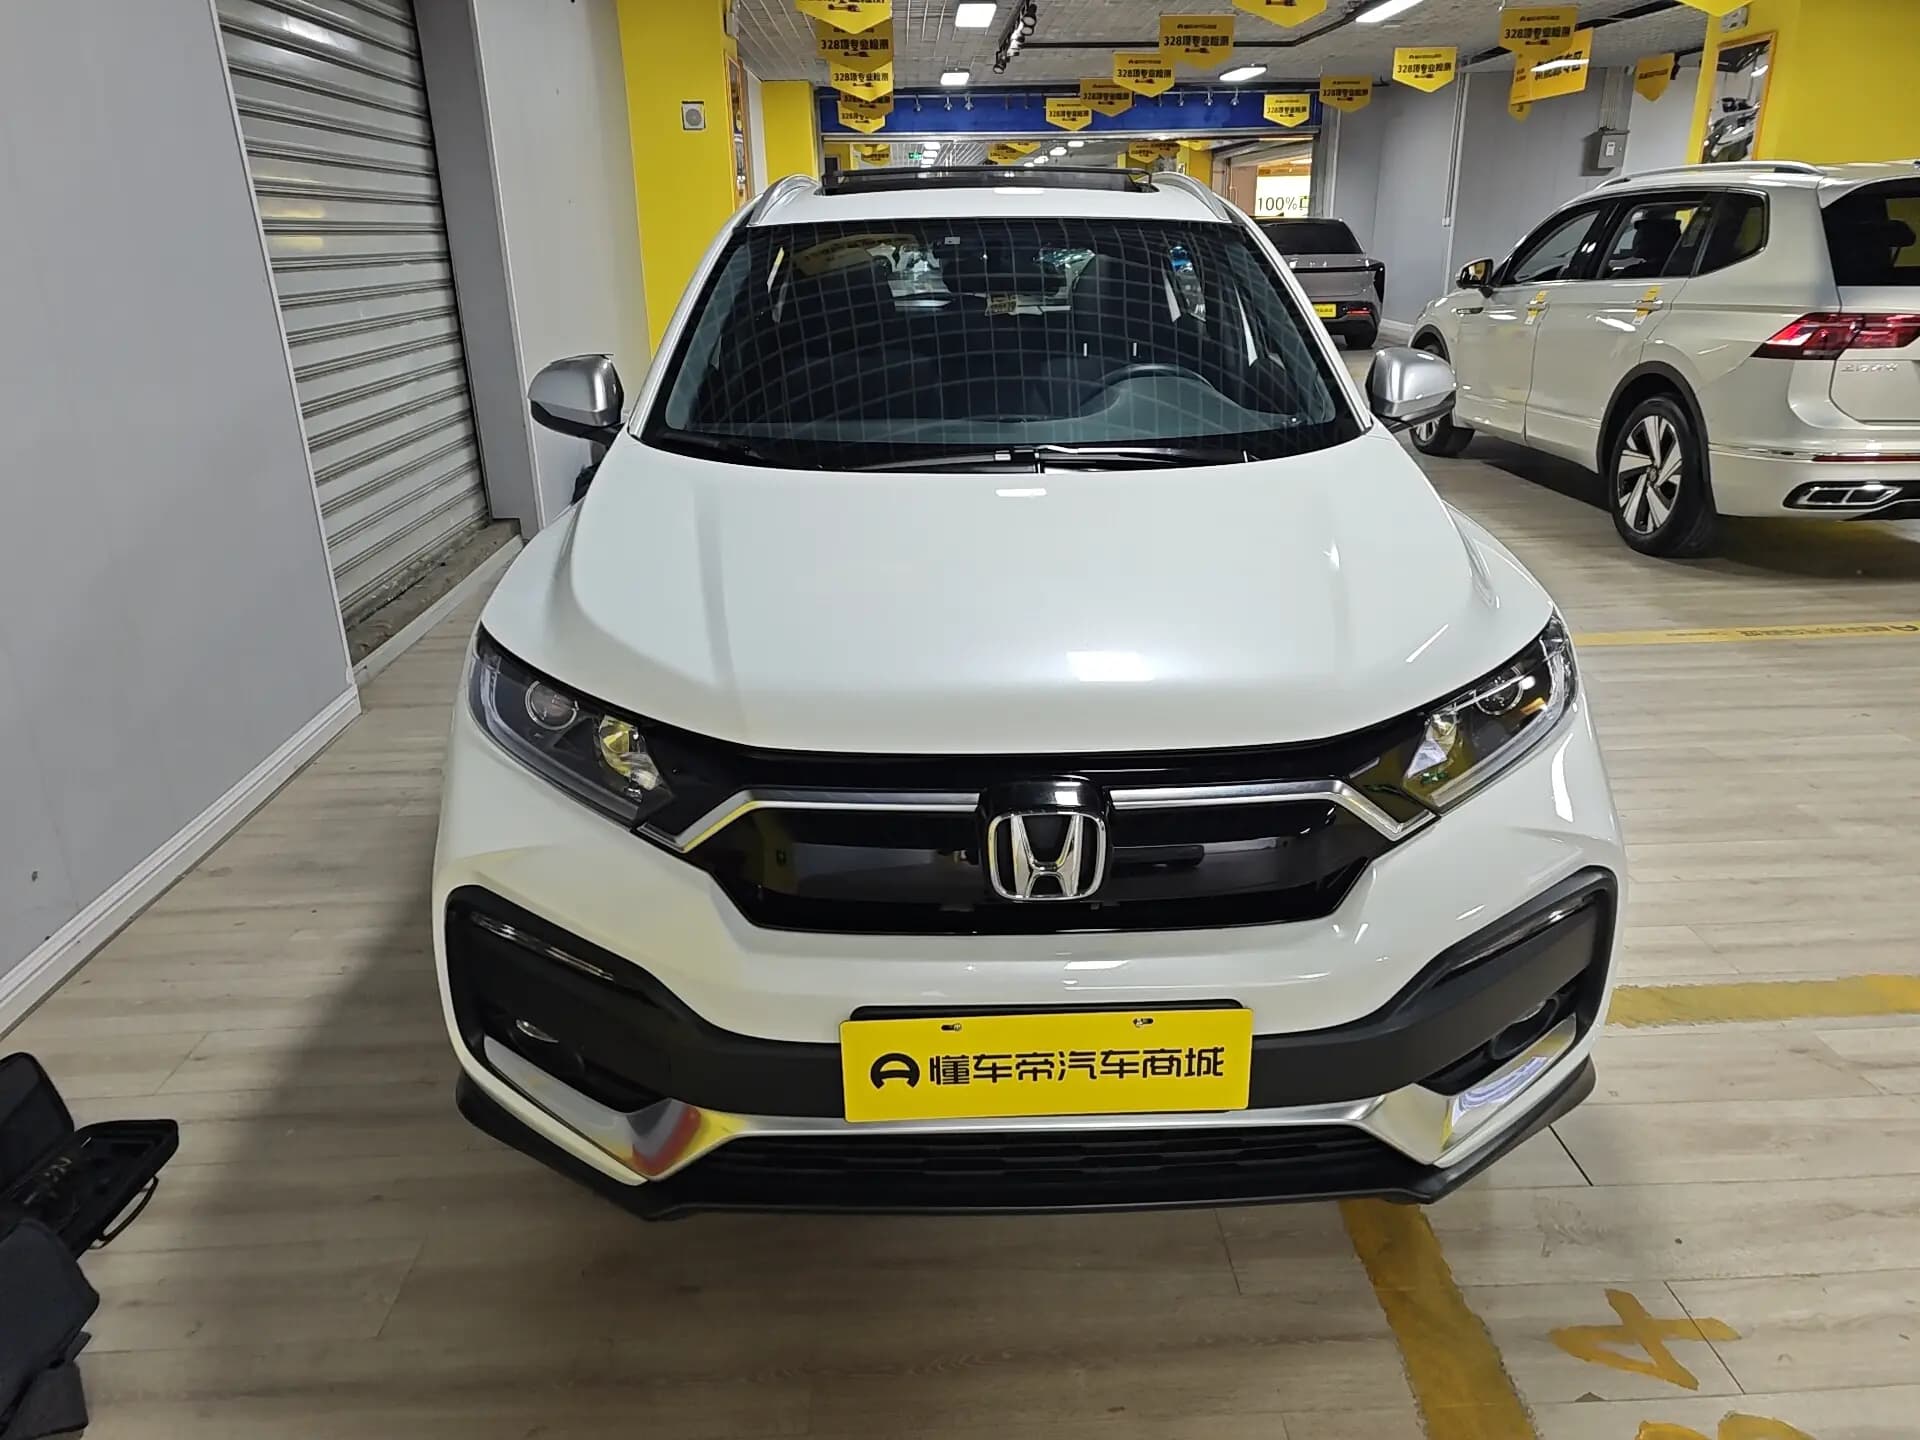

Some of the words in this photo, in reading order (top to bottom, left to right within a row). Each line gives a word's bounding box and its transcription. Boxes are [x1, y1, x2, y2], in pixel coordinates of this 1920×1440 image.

[929, 1046, 1224, 1086] 懂车帝汽车商城
